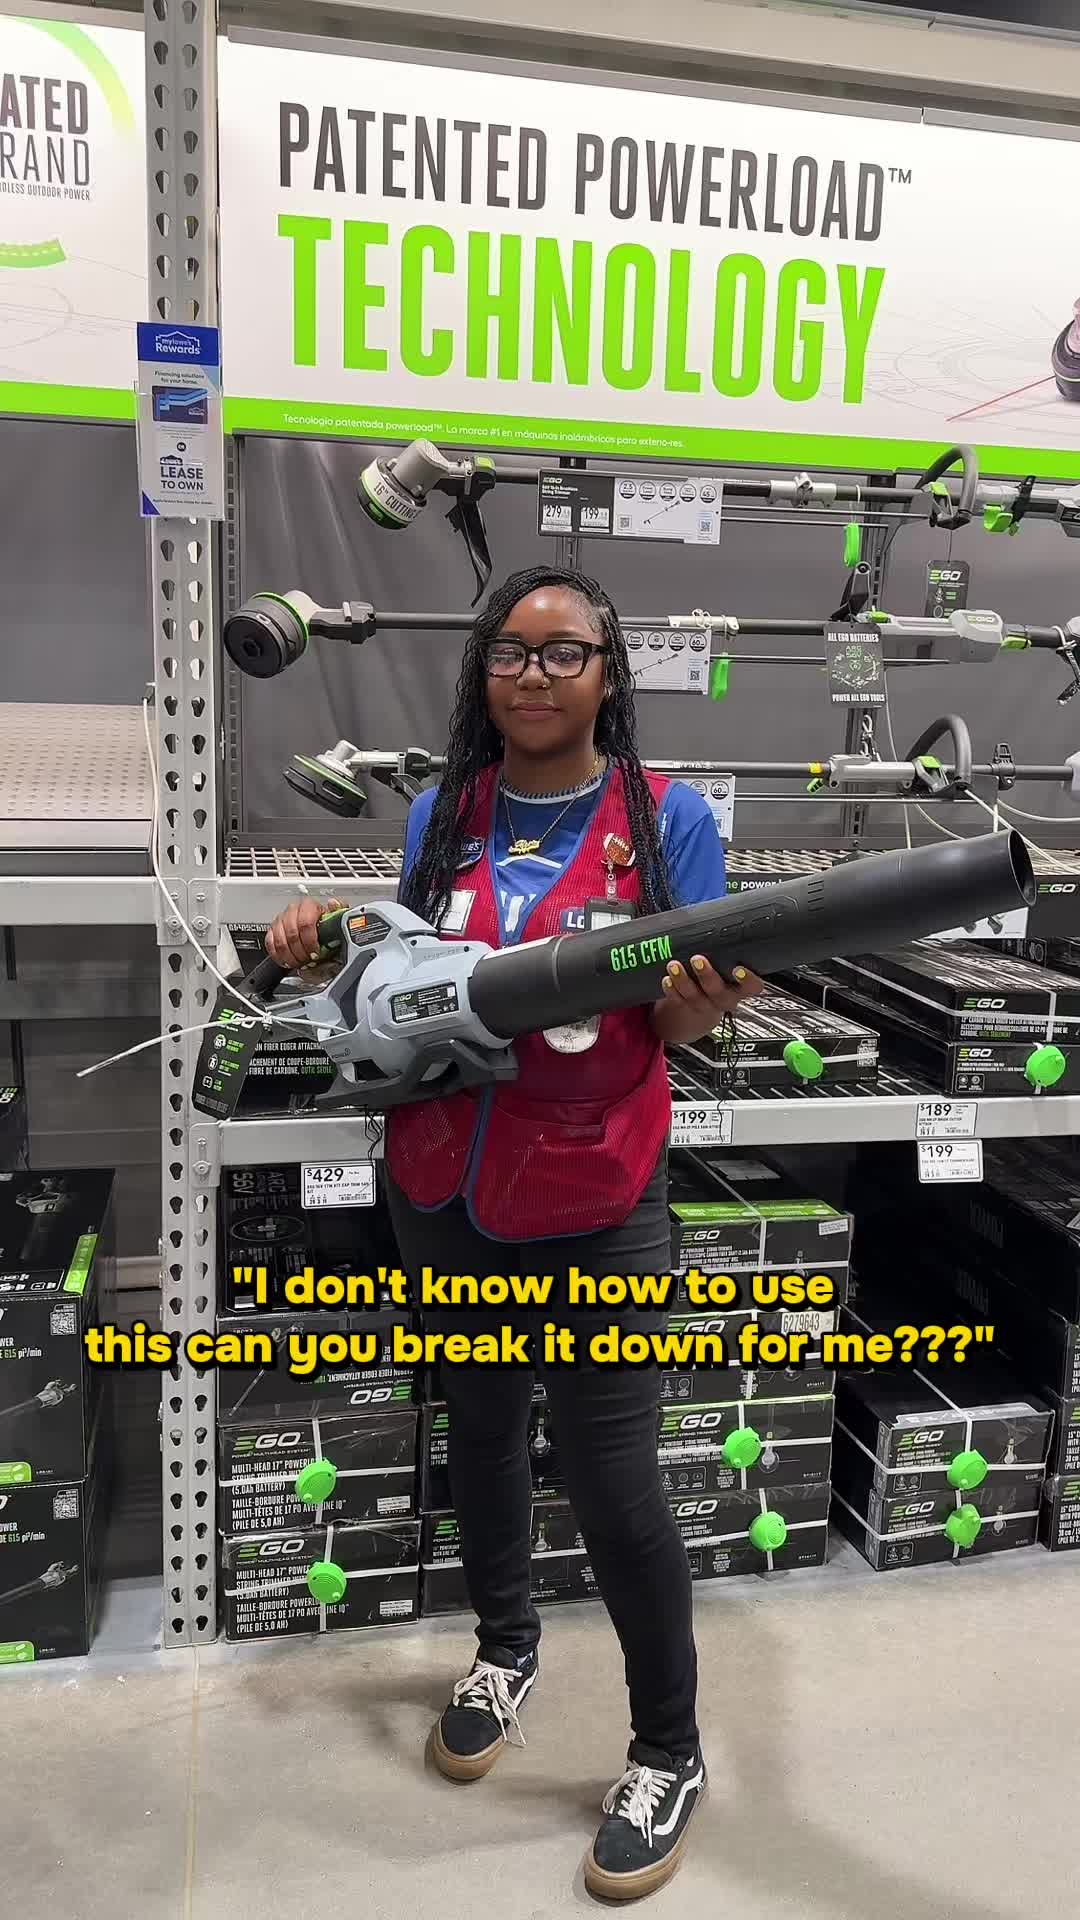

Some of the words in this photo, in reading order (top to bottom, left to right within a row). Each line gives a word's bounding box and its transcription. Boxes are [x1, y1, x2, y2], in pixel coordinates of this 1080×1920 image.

[0, 73, 89, 135] ATED
[279, 102, 547, 211] PATENTED
[0, 182, 25, 194] DLESS
[28, 184, 61, 197] OUTDOOR
[64, 188, 90, 201] POWER
[277, 214, 886, 405] TECHNOLOGY
[155, 342, 201, 355] Rewards
[335, 419, 384, 430] patentada
[458, 427, 488, 437] marca
[489, 427, 501, 437] #1
[616, 437, 637, 446] para
[160, 466, 204, 480] LEASE
[160, 480, 176, 489] TO
[177, 481, 204, 491] OWN
[546, 504, 562, 518] 279
[584, 506, 600, 520] 199
[929, 570, 962, 581] EGO
[827, 632, 838, 642] ALL
[849, 633, 880, 643] BATTERIES
[1038, 883, 1077, 894] EGO
[610, 944, 638, 972] 615
[640, 934, 673, 965] CFM
[963, 998, 1006, 1009] EGO
[958, 1048, 993, 1058] EGO
[278, 1057, 286, 1066] DE
[265, 1066, 273, 1075] DE
[920, 1103, 952, 1116] $189
[673, 1111, 707, 1124] $199
[920, 1145, 953, 1158] $199
[306, 1168, 344, 1183] $429
[682, 1230, 721, 1241] EGO
[782, 1314, 821, 1333] 6279643
[4, 1348, 17, 1359] 615
[349, 1385, 412, 1405] EGO
[660, 1412, 722, 1431] EGO
[232, 1431, 305, 1451] EGO
[899, 1430, 945, 1445] EGO
[231, 1462, 271, 1475] MULTI-HEAD
[232, 1495, 285, 1509] TAILLE-BORDURE
[891, 1500, 935, 1517] EGO
[274, 1505, 284, 1515] DE
[232, 1518, 249, 1531] (PILE
[250, 1517, 259, 1528] DE
[272, 1515, 285, 1527] AH)
[7, 1533, 20, 1542] 615
[237, 1539, 308, 1558] EGO
[236, 1567, 275, 1581] MULTI-HEAD
[236, 1599, 289, 1614] TAILLE-BORDURE
[236, 1610, 278, 1624] MULTI-TÊTES
[278, 1608, 287, 1618] DE
[326, 1605, 338, 1614] INE
[236, 1623, 254, 1635] (PILE
[254, 1622, 264, 1633] DE
[276, 1620, 290, 1631] AH)
